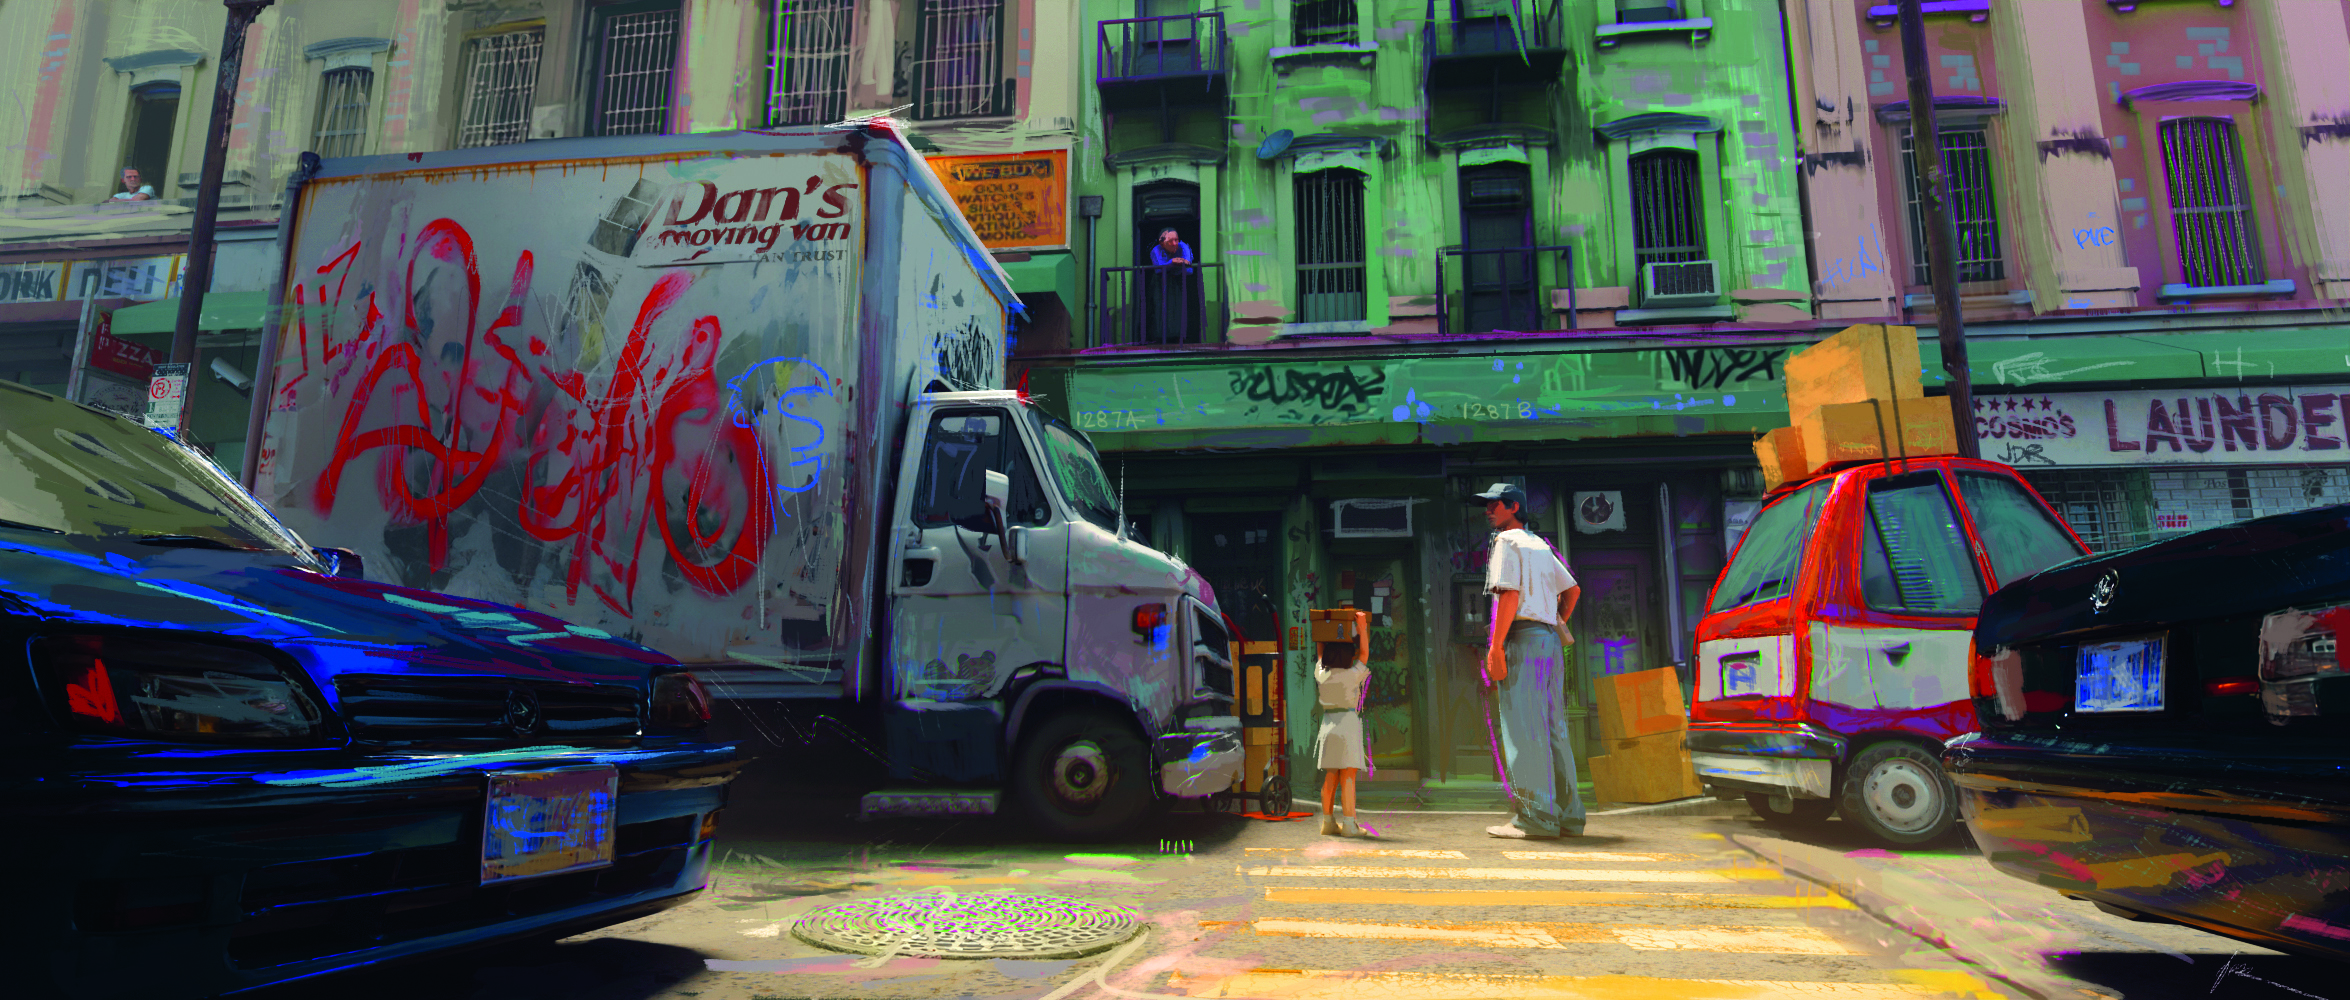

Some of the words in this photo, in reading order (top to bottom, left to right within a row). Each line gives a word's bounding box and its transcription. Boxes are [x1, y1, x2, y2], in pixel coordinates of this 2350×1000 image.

[963, 165, 994, 179] WE
[1001, 163, 1040, 177] BUY
[663, 174, 858, 226] Dan's
[973, 183, 1018, 193] GOLD
[656, 223, 783, 253] moving
[790, 222, 851, 242] van
[792, 249, 847, 262] TRUST
[79, 265, 156, 298] DELI
[1076, 410, 1146, 430] 1287A
[1975, 409, 2077, 439] COSMO'S
[2103, 393, 2350, 453] LAUNDE
